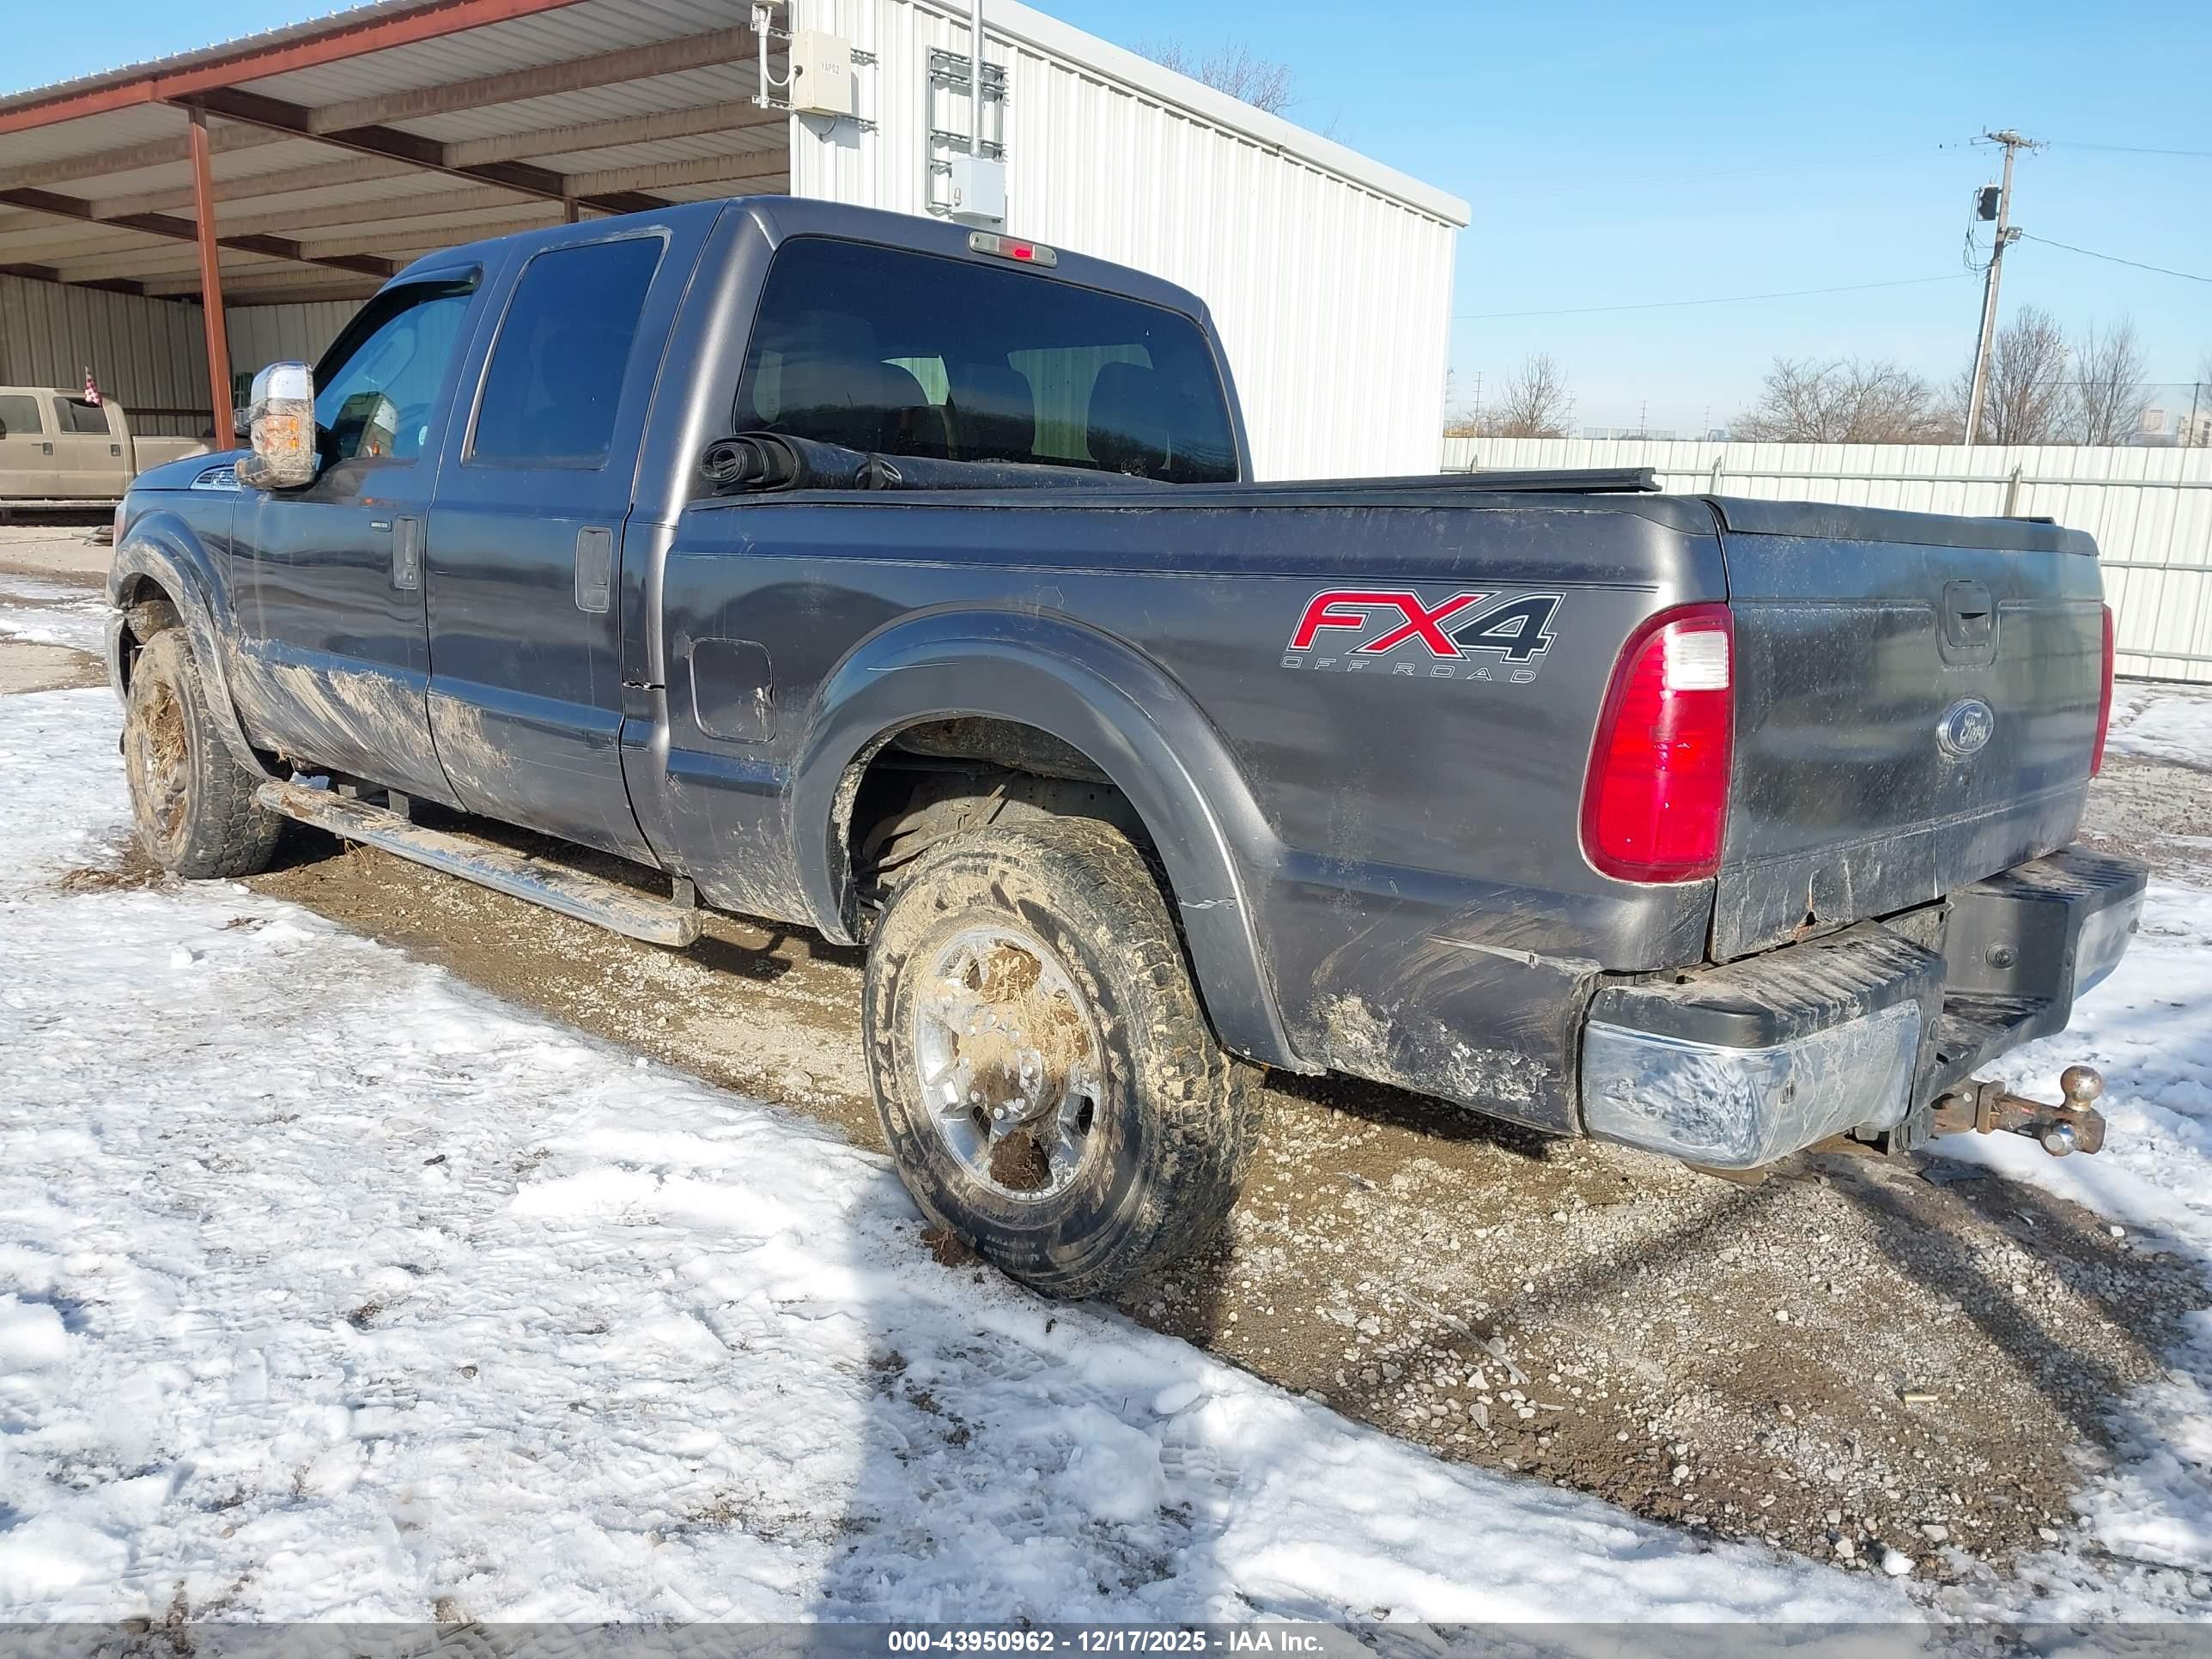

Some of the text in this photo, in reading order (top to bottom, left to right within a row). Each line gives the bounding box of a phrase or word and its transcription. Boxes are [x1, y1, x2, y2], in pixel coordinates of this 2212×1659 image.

[1286, 586, 1566, 665] FX4
[1281, 656, 1536, 684] OFF ROAD
[1960, 712, 1988, 744] Ford
